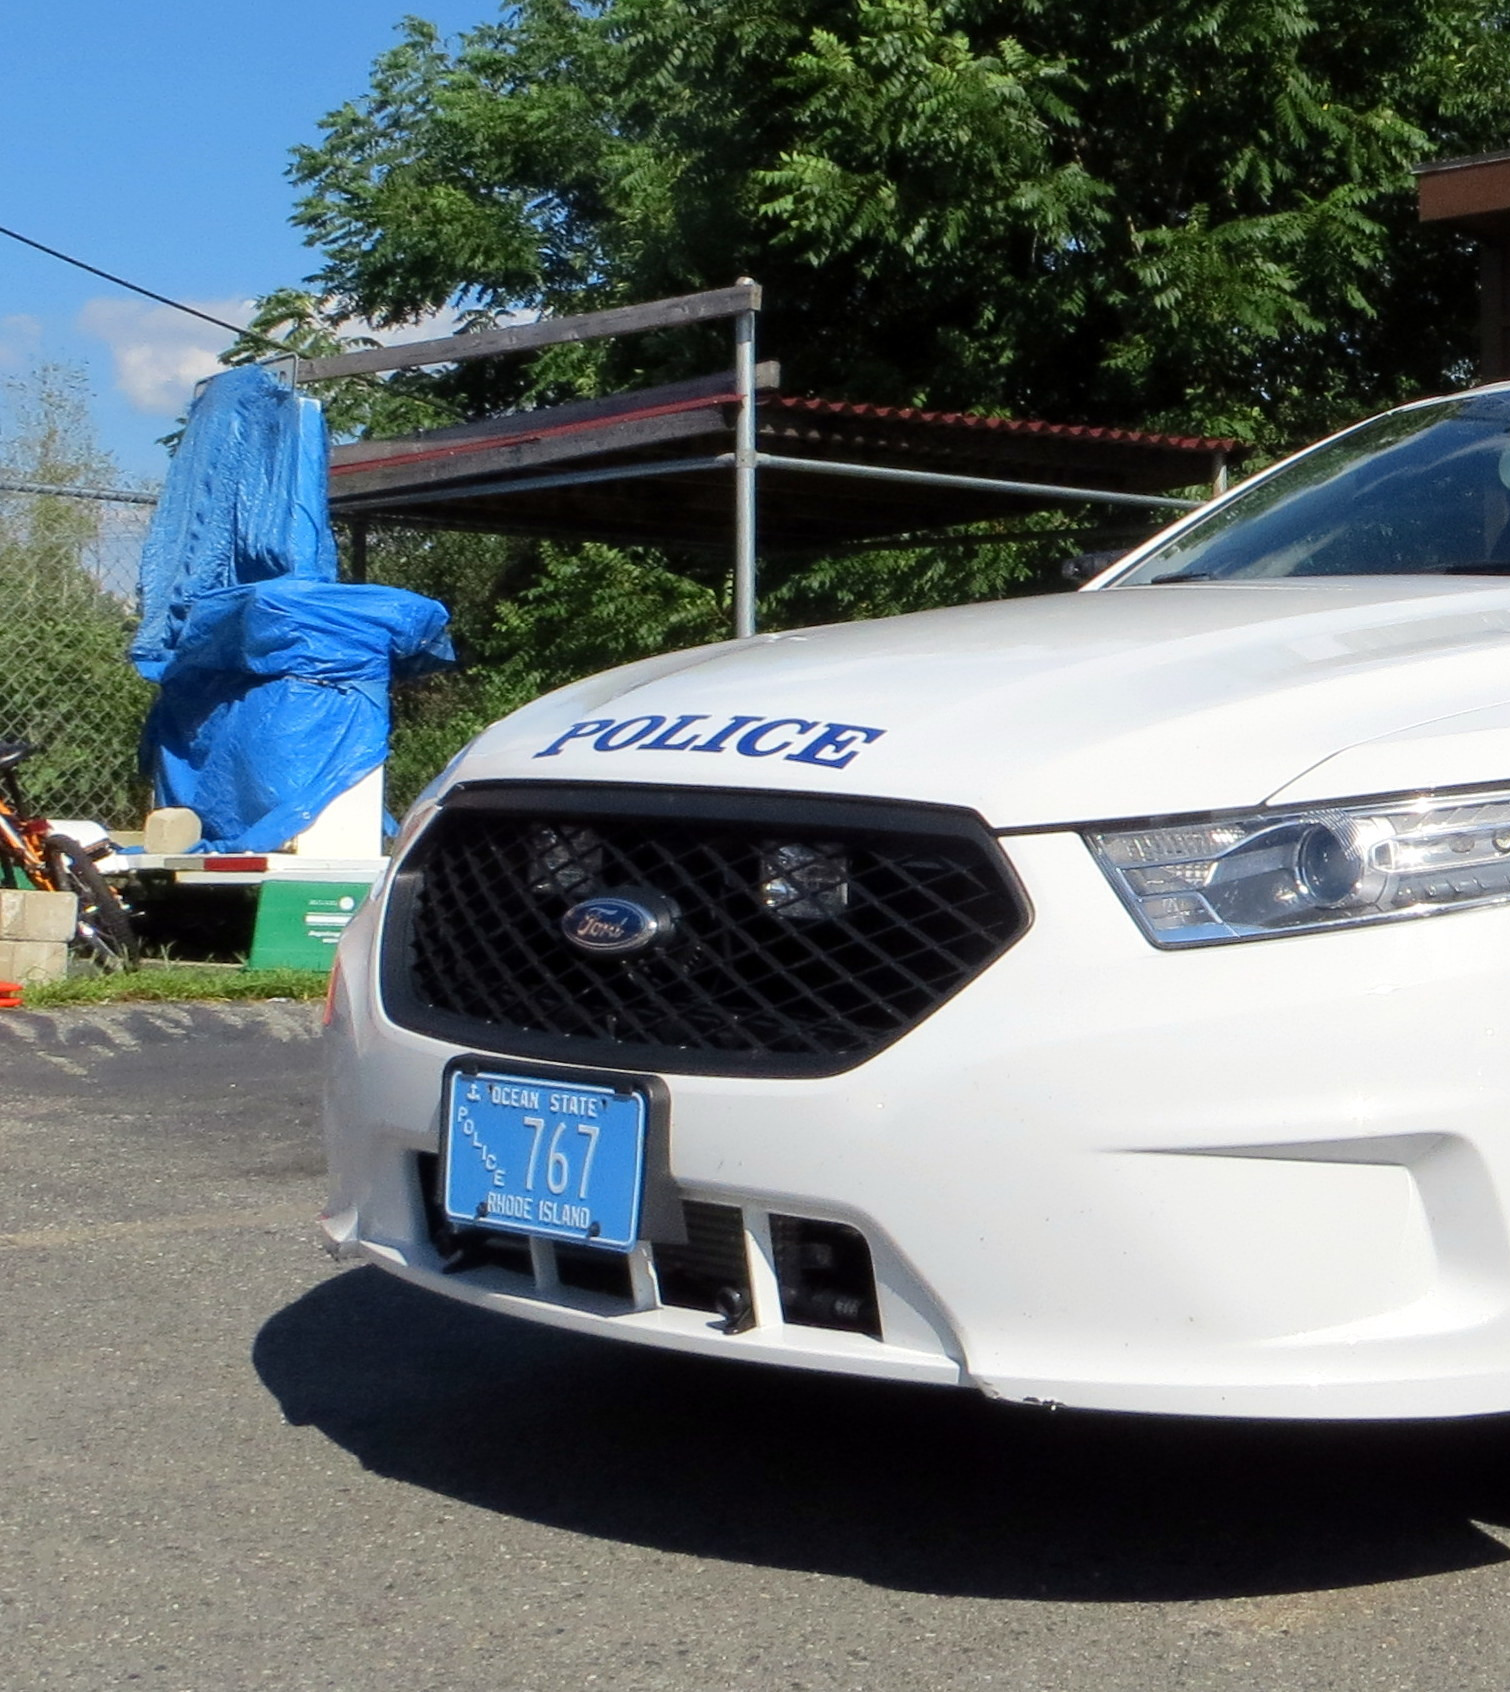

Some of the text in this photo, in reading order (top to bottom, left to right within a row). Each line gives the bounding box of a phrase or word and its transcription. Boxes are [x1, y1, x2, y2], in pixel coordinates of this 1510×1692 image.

[531, 714, 889, 770] POLICE
[491, 1086, 598, 1117] OCEAN STATE
[457, 1106, 507, 1187] POLICE
[523, 1116, 600, 1200] 767
[487, 1191, 591, 1229] RHODE ISLAND
